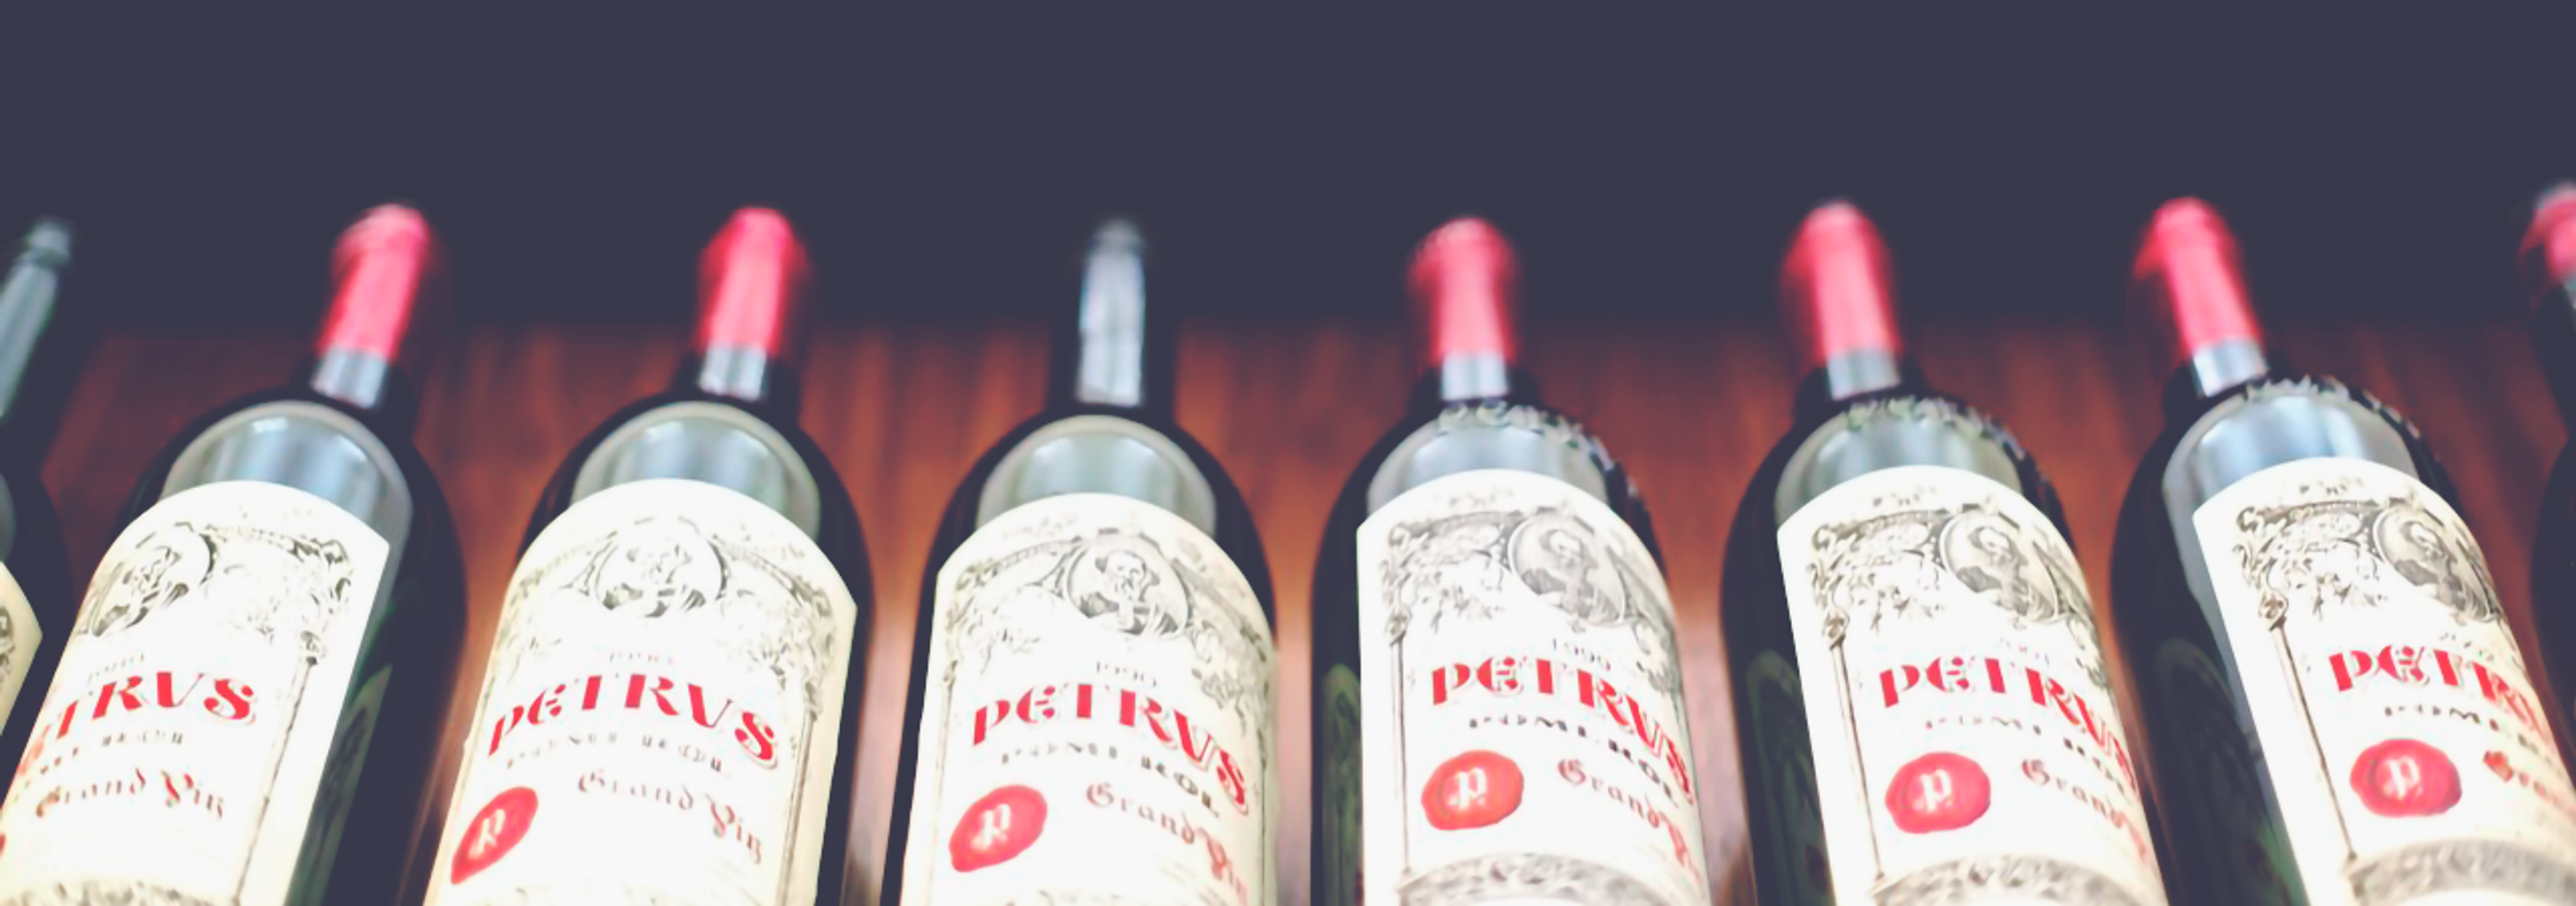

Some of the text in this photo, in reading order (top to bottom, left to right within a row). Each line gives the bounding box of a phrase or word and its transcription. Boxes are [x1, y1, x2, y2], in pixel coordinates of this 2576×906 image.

[488, 673, 778, 770] PETRVS
[972, 683, 1249, 816] PETRVS
[1431, 655, 1696, 806] PETRVS
[1085, 782, 1195, 845] Grand
